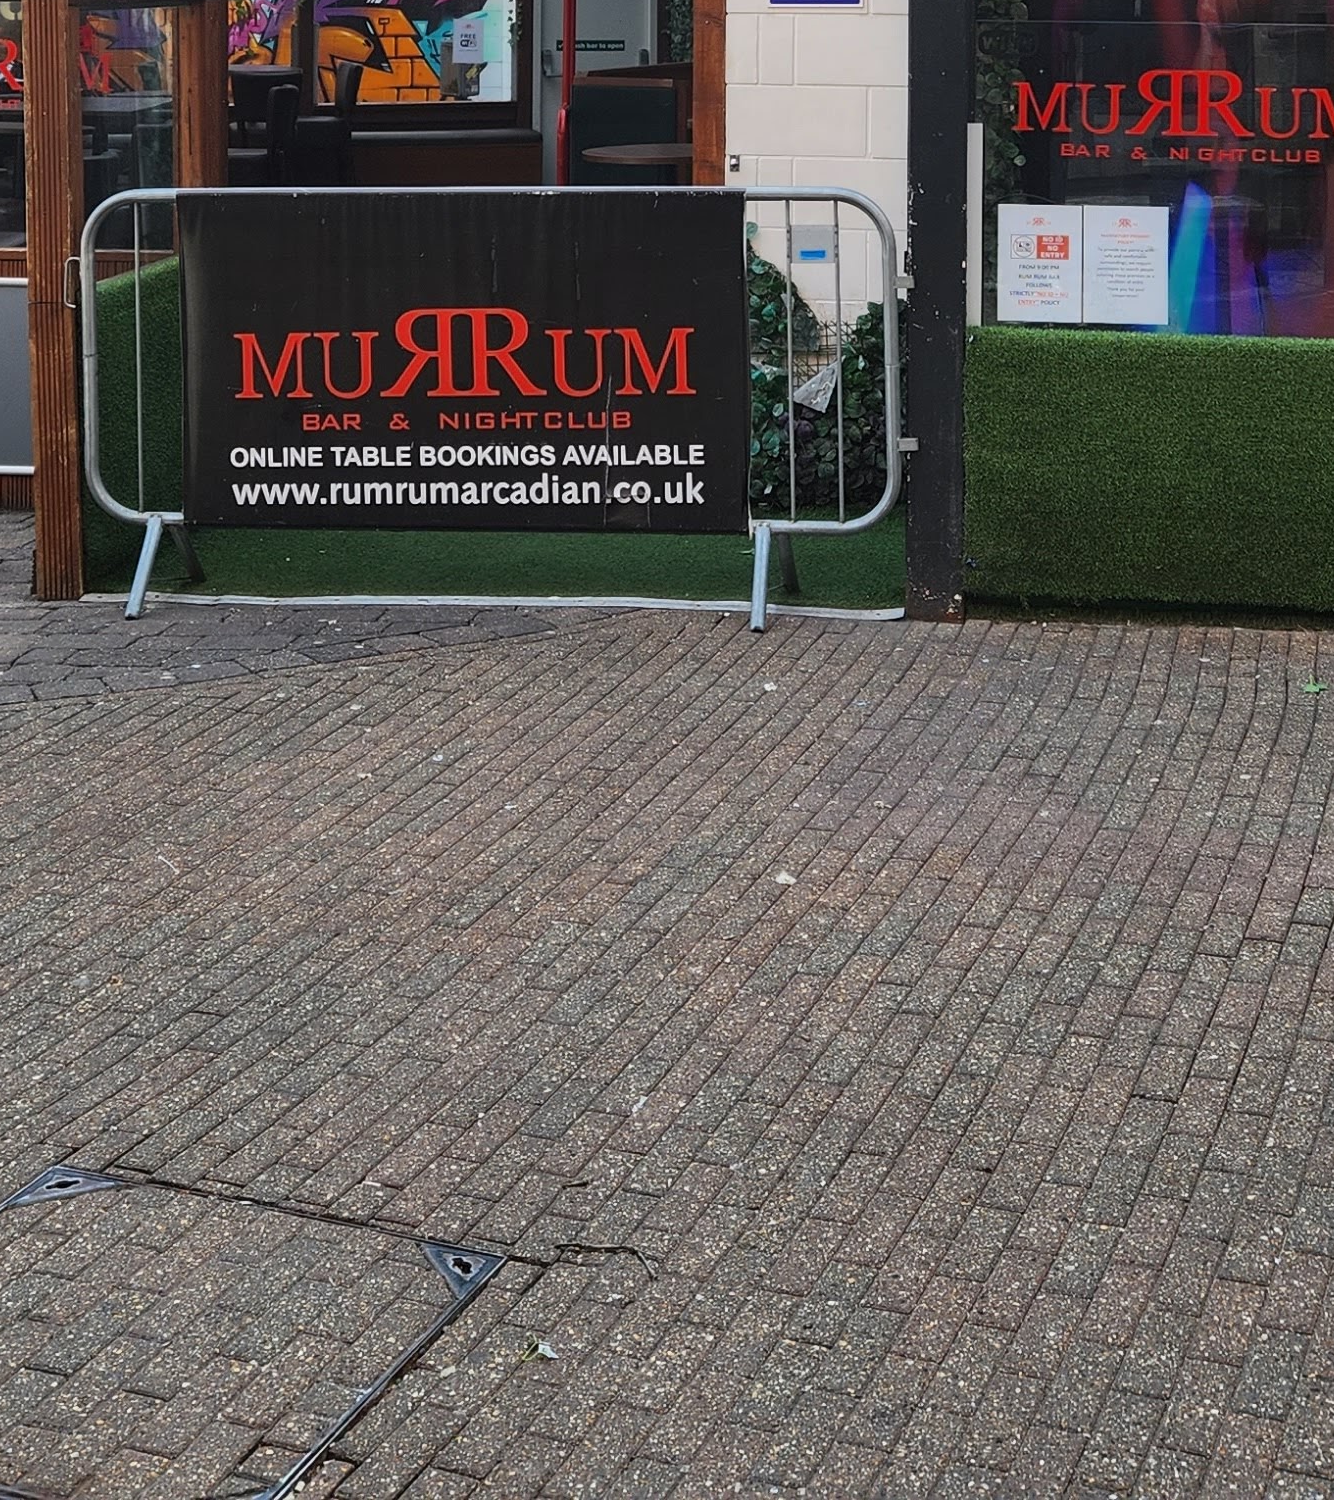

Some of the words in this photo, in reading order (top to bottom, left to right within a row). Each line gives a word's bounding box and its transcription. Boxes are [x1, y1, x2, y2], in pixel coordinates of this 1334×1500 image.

[1060, 143, 1111, 159] BAR
[1131, 146, 1147, 160] &
[1169, 147, 1322, 163] NIGHTCLUB
[302, 413, 361, 431] BAR
[389, 412, 410, 430] &
[439, 411, 632, 430] NIGHTCLUB
[230, 445, 323, 468] ONLINE
[329, 445, 412, 467] TABLE
[419, 444, 556, 467] BOOKINGS
[562, 444, 705, 466] AVAILABLE
[232, 472, 705, 506] www.rumrumarcadian.co.uk
